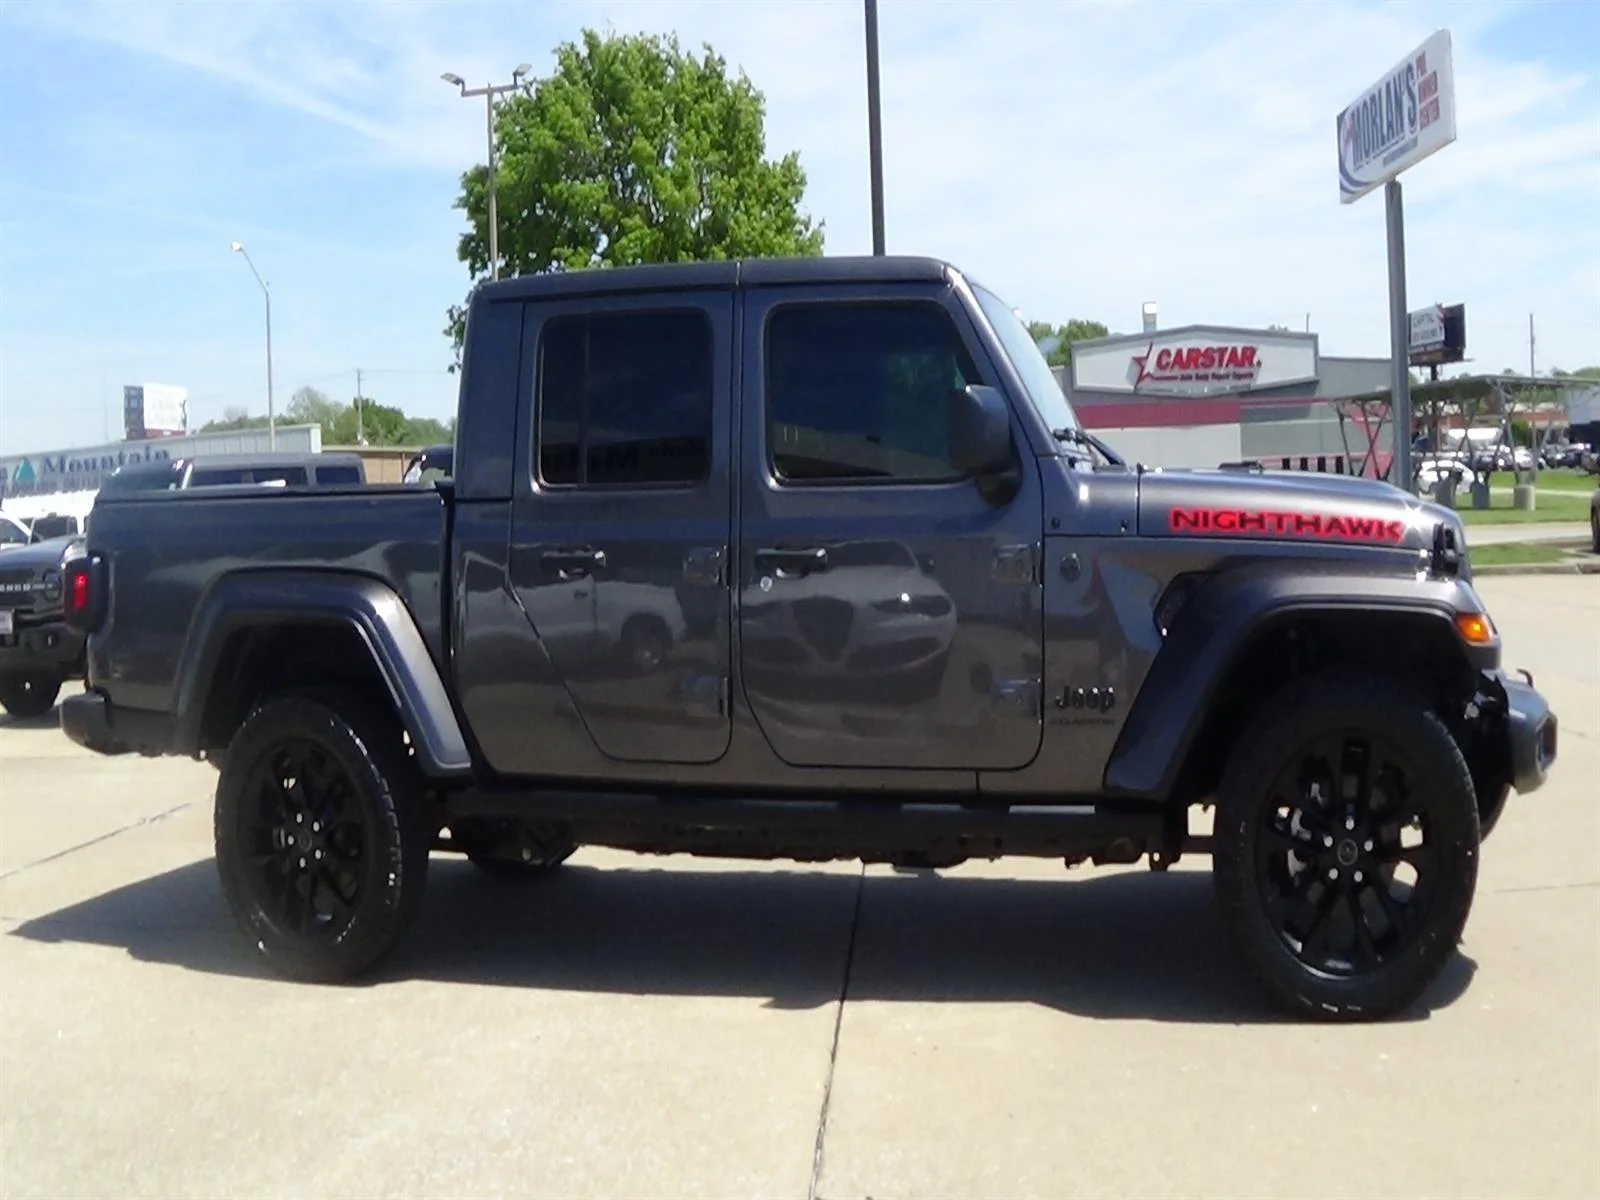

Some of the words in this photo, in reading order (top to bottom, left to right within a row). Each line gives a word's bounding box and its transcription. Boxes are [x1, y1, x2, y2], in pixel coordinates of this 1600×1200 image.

[1352, 62, 1417, 170] MORLAN'S
[1156, 346, 1257, 370] CARSTAR
[43, 446, 171, 474] Mountain
[1169, 507, 1406, 541] NIGHTHAWK
[1055, 685, 1116, 714] Jeep
